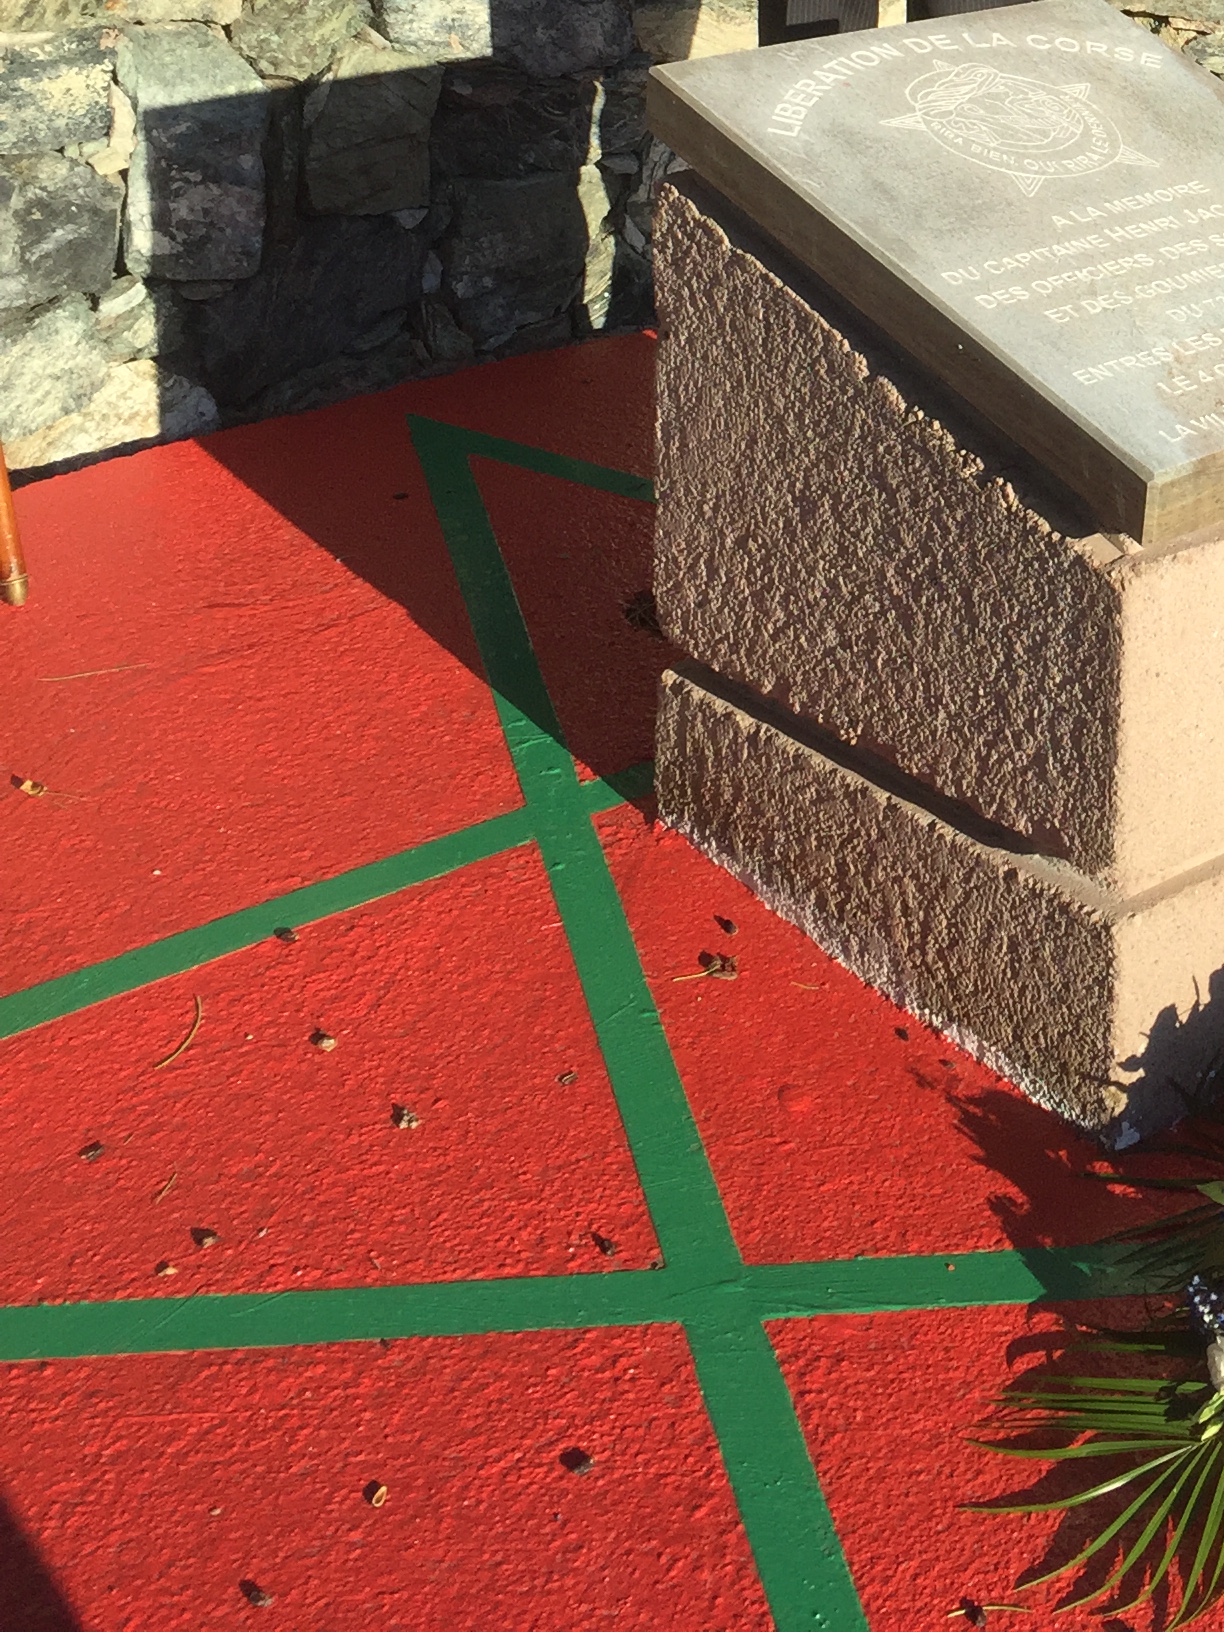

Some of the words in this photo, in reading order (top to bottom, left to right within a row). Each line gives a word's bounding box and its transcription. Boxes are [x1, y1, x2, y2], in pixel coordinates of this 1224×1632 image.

[767, 42, 902, 138] LIBERATION
[903, 34, 962, 55] DE
[962, 31, 1017, 50] LA
[1026, 33, 1165, 69] CORSE
[1052, 214, 1072, 232] A
[1069, 206, 1107, 222] LA
[1104, 180, 1210, 214] MEMOIRE
[941, 266, 980, 285] DU
[983, 234, 1110, 274] CAPITAINE
[1104, 216, 1179, 242] HENRI
[974, 286, 1030, 309] DES
[1159, 239, 1208, 261] DES
[1044, 304, 1079, 323] ET
[1081, 291, 1133, 314] DES
[1165, 303, 1202, 322] DU
[1072, 346, 1174, 386] ENTRES
[1171, 332, 1222, 356] LES
[1156, 375, 1198, 395] LE
[1198, 369, 1214, 383] 4
[1158, 424, 1198, 443] LA
